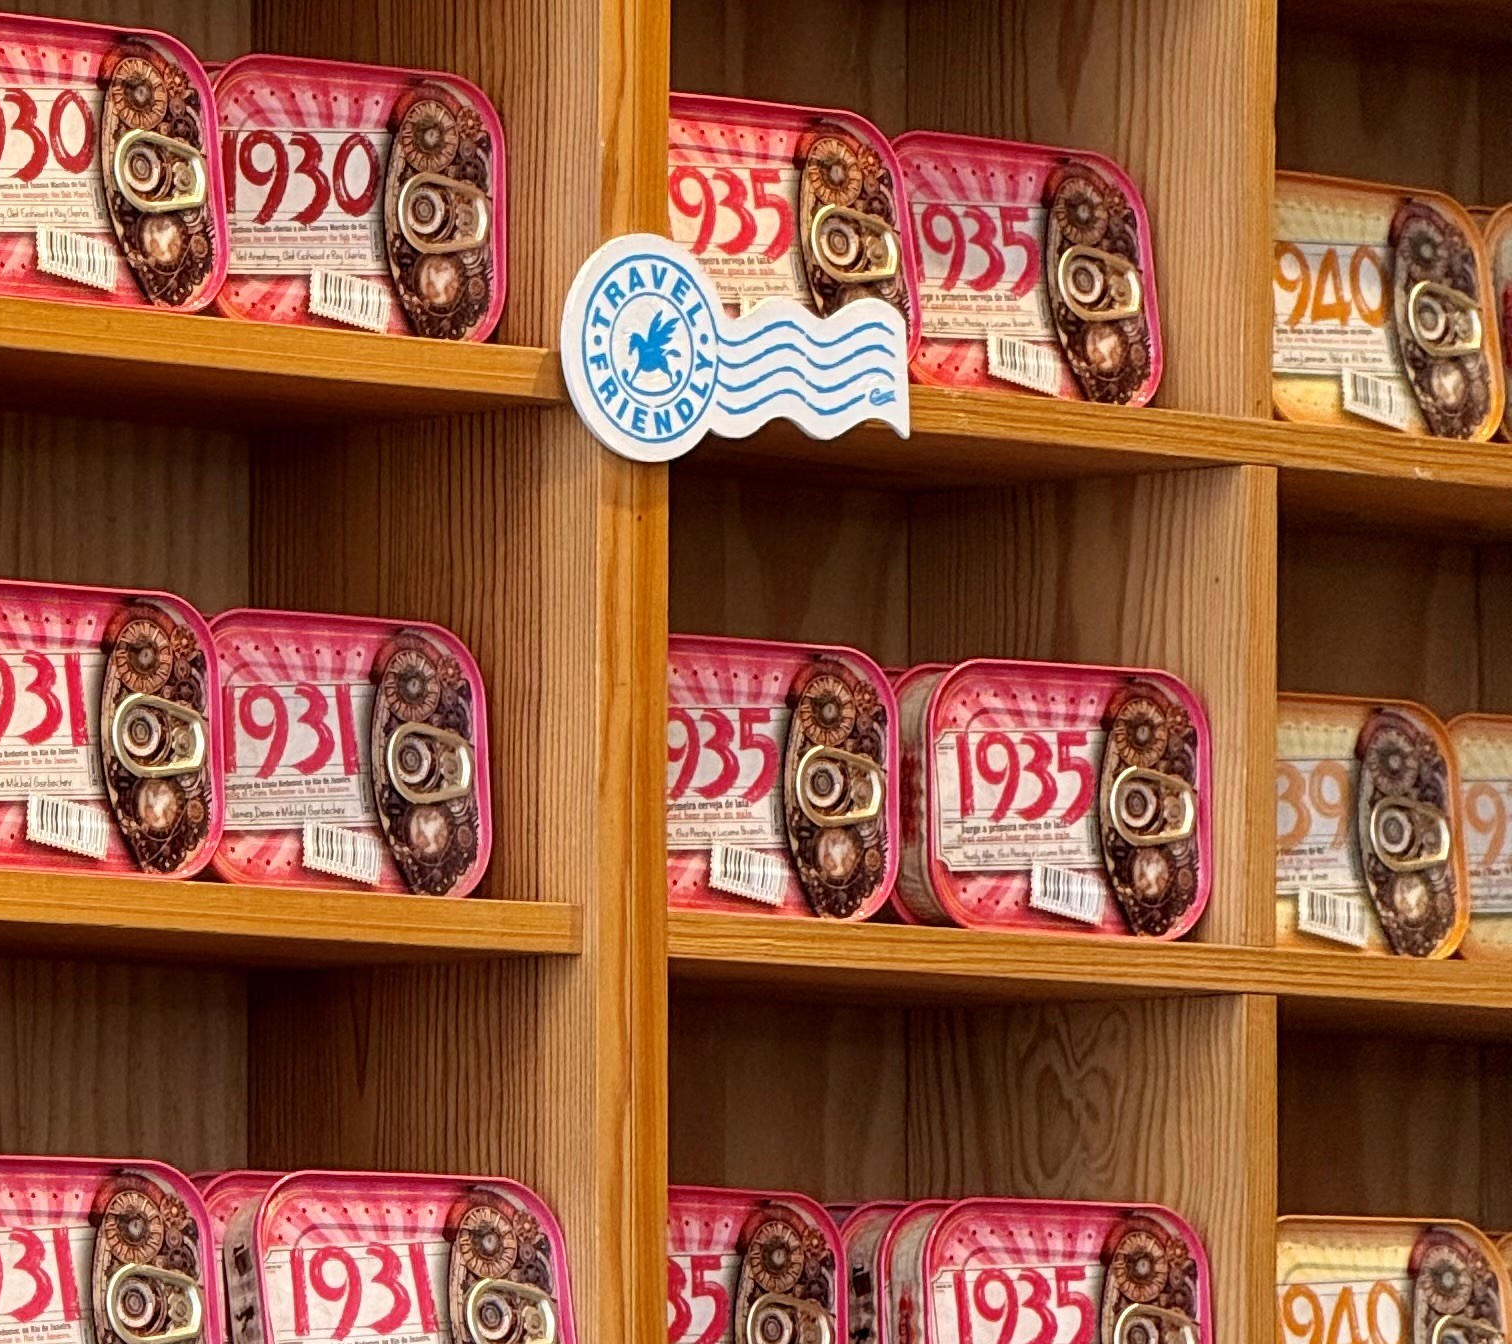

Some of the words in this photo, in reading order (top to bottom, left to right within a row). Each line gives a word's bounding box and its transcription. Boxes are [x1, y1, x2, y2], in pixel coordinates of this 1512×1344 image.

[221, 128, 380, 225] 1930
[669, 165, 796, 261] 935
[592, 264, 707, 328] TRAVEL
[1274, 240, 1388, 329] 940
[589, 353, 715, 436] FRIENDLY
[224, 681, 360, 780] 1931
[668, 707, 781, 804] 935
[955, 730, 1095, 825] 1935
[1276, 757, 1351, 850] 39
[289, 1240, 439, 1342] 1931
